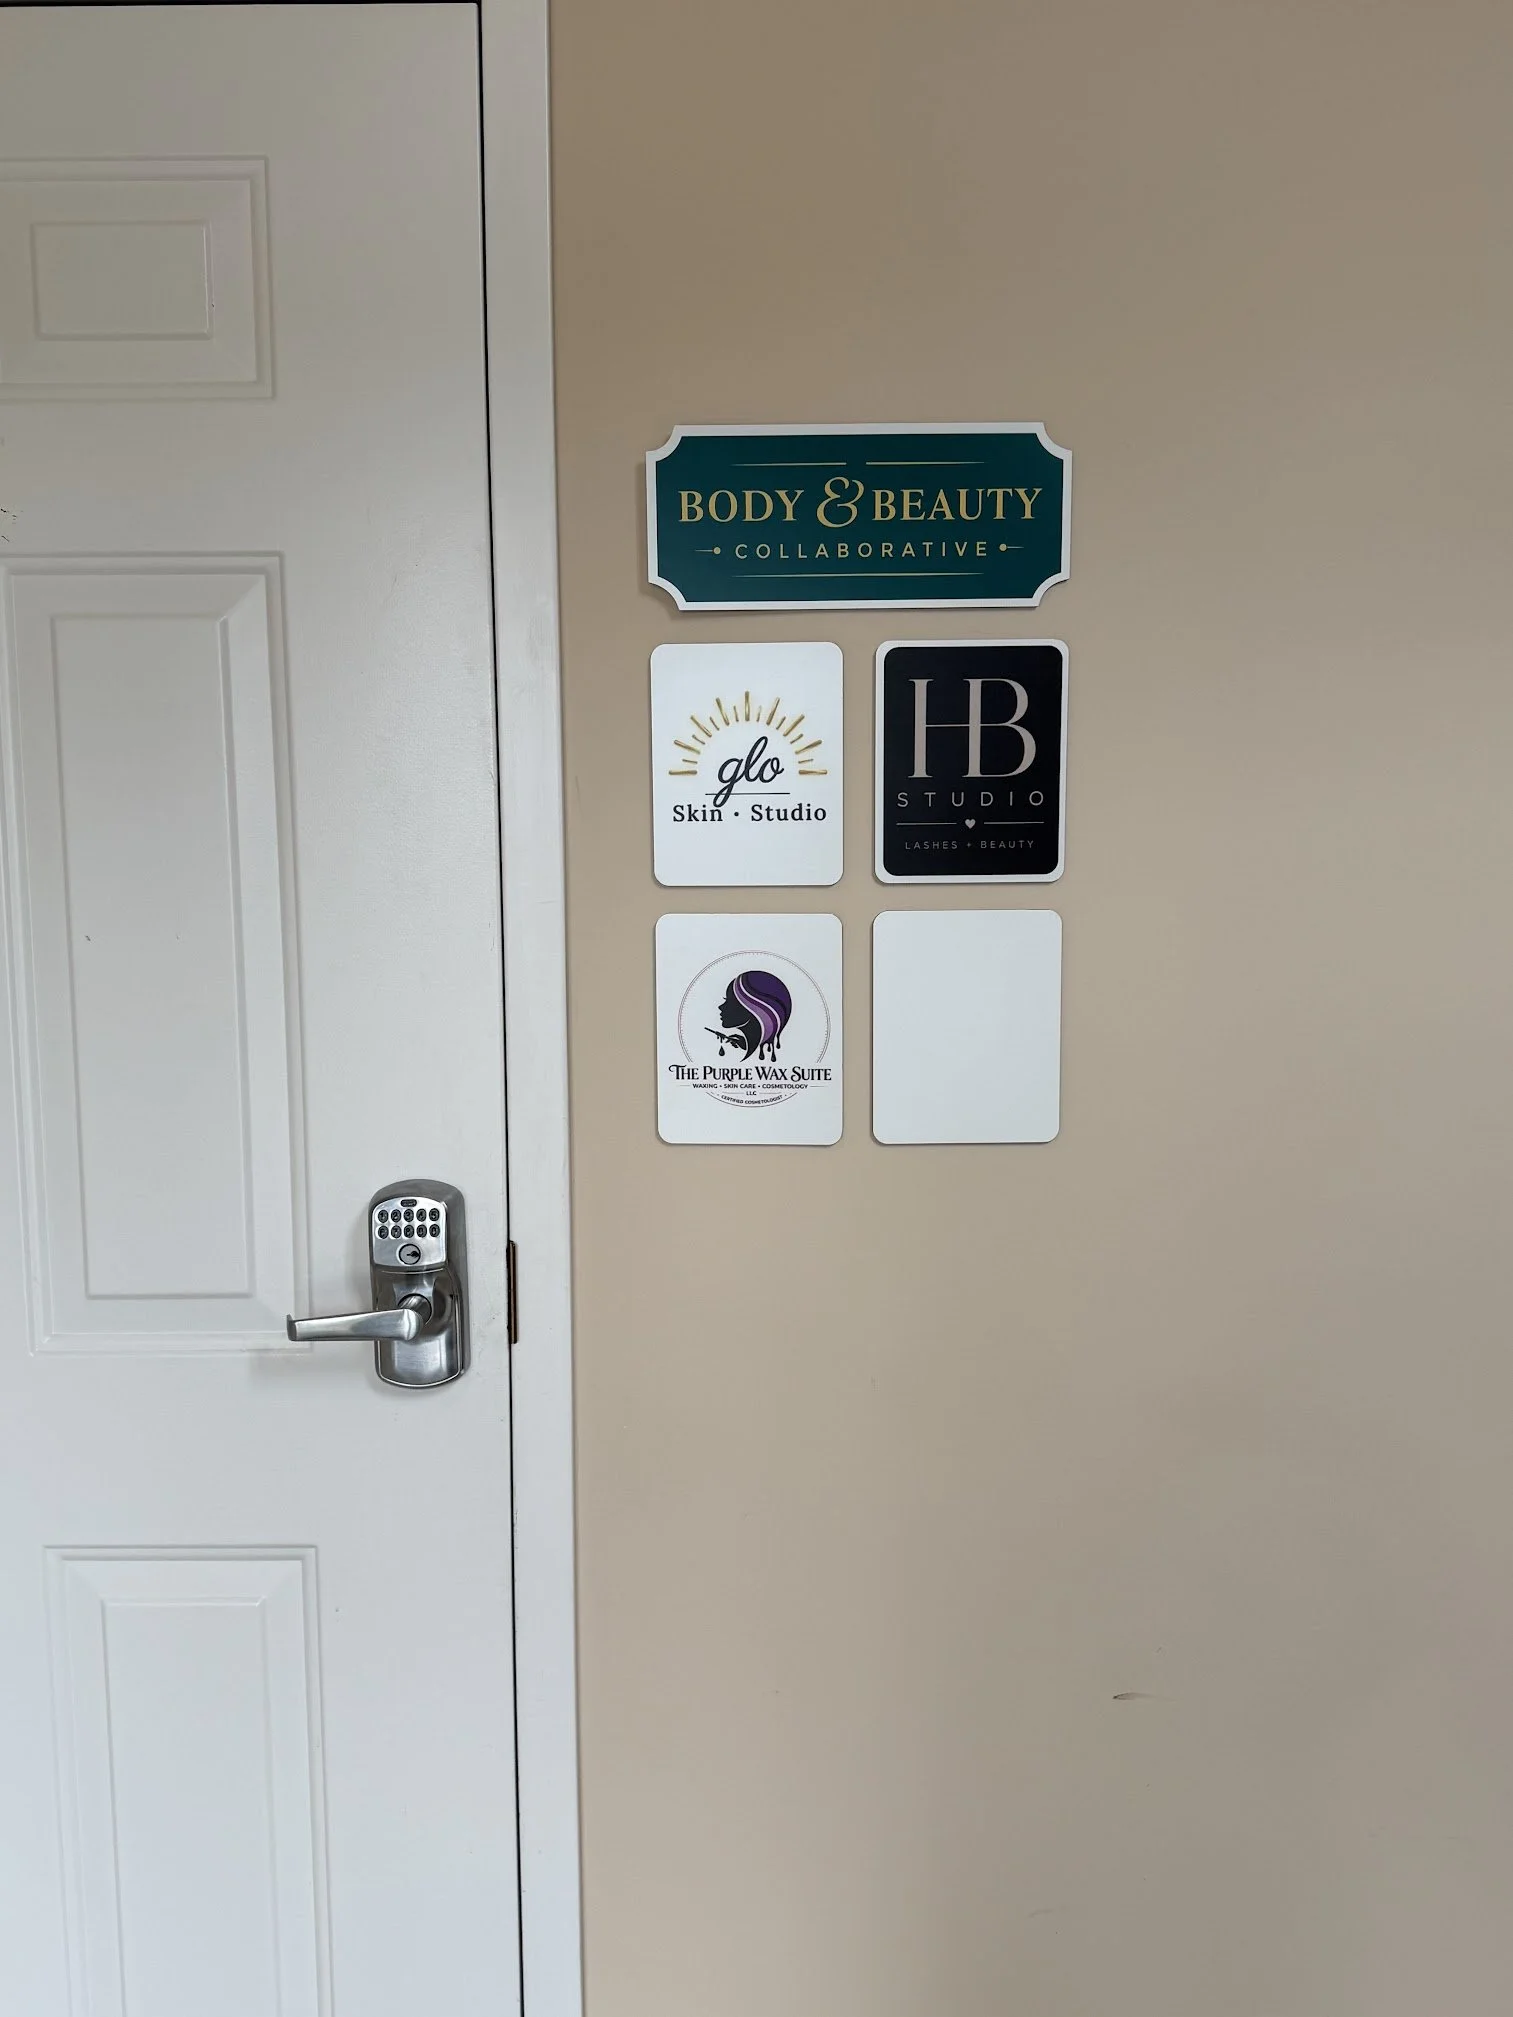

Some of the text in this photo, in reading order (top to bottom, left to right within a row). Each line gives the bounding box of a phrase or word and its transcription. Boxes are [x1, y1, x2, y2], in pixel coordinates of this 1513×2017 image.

[678, 476, 1043, 528] BODY & BEAUTY
[734, 541, 988, 559] COLLABORATIVE
[907, 678, 1037, 778] HB
[712, 735, 785, 808] glo
[896, 790, 1045, 808] STUDIO
[672, 803, 828, 823] Skin Studio
[904, 841, 958, 850] LASHES
[980, 840, 1035, 849] BEAUTY
